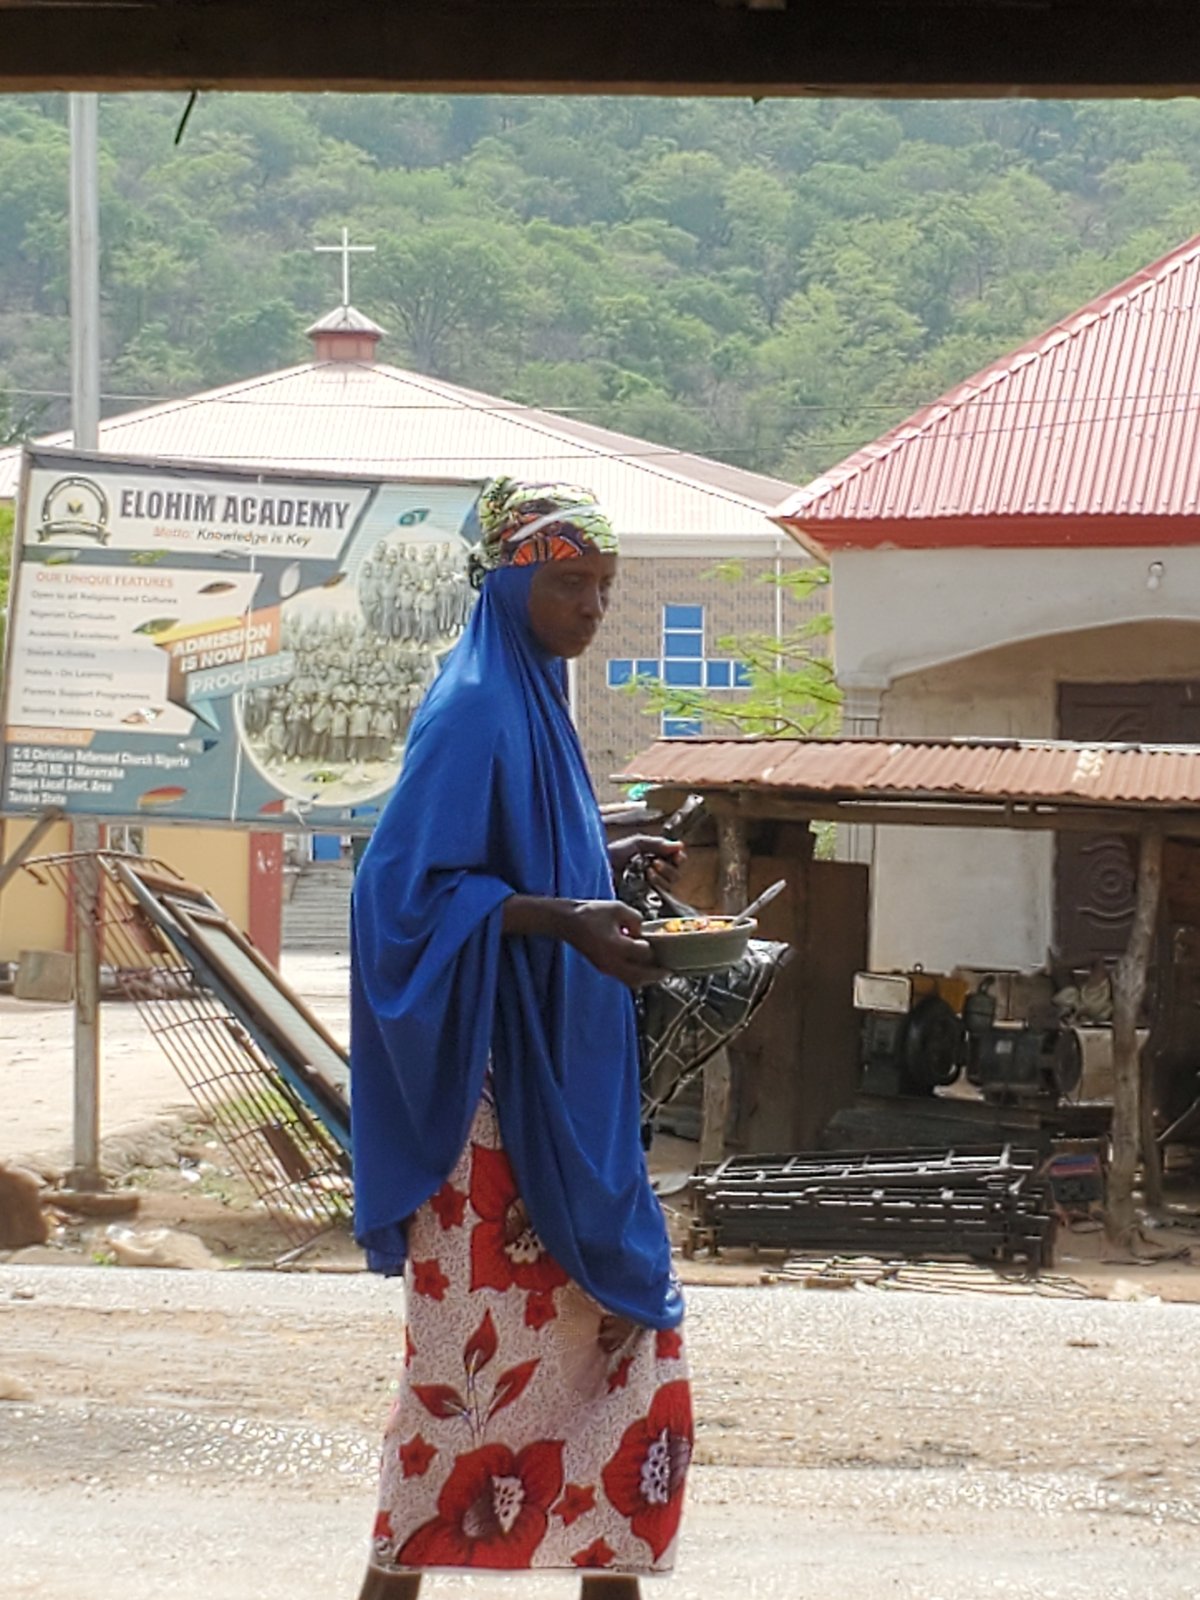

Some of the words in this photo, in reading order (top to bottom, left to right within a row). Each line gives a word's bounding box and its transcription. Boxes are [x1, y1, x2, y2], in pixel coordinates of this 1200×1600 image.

[120, 490, 216, 522] ELOHIM
[221, 496, 351, 530] ACADEMY
[197, 529, 268, 545] Knowledge
[271, 533, 283, 543] is
[286, 533, 312, 547] Key
[31, 590, 54, 600] Open
[36, 572, 62, 583] OUR
[65, 573, 113, 586] UNIQUE
[115, 575, 174, 587] FEATURES
[171, 621, 273, 657] ADMISSION
[180, 654, 198, 673] IS
[200, 645, 245, 669] NOW
[249, 639, 268, 659] IN
[189, 660, 294, 695] PROGRESS
